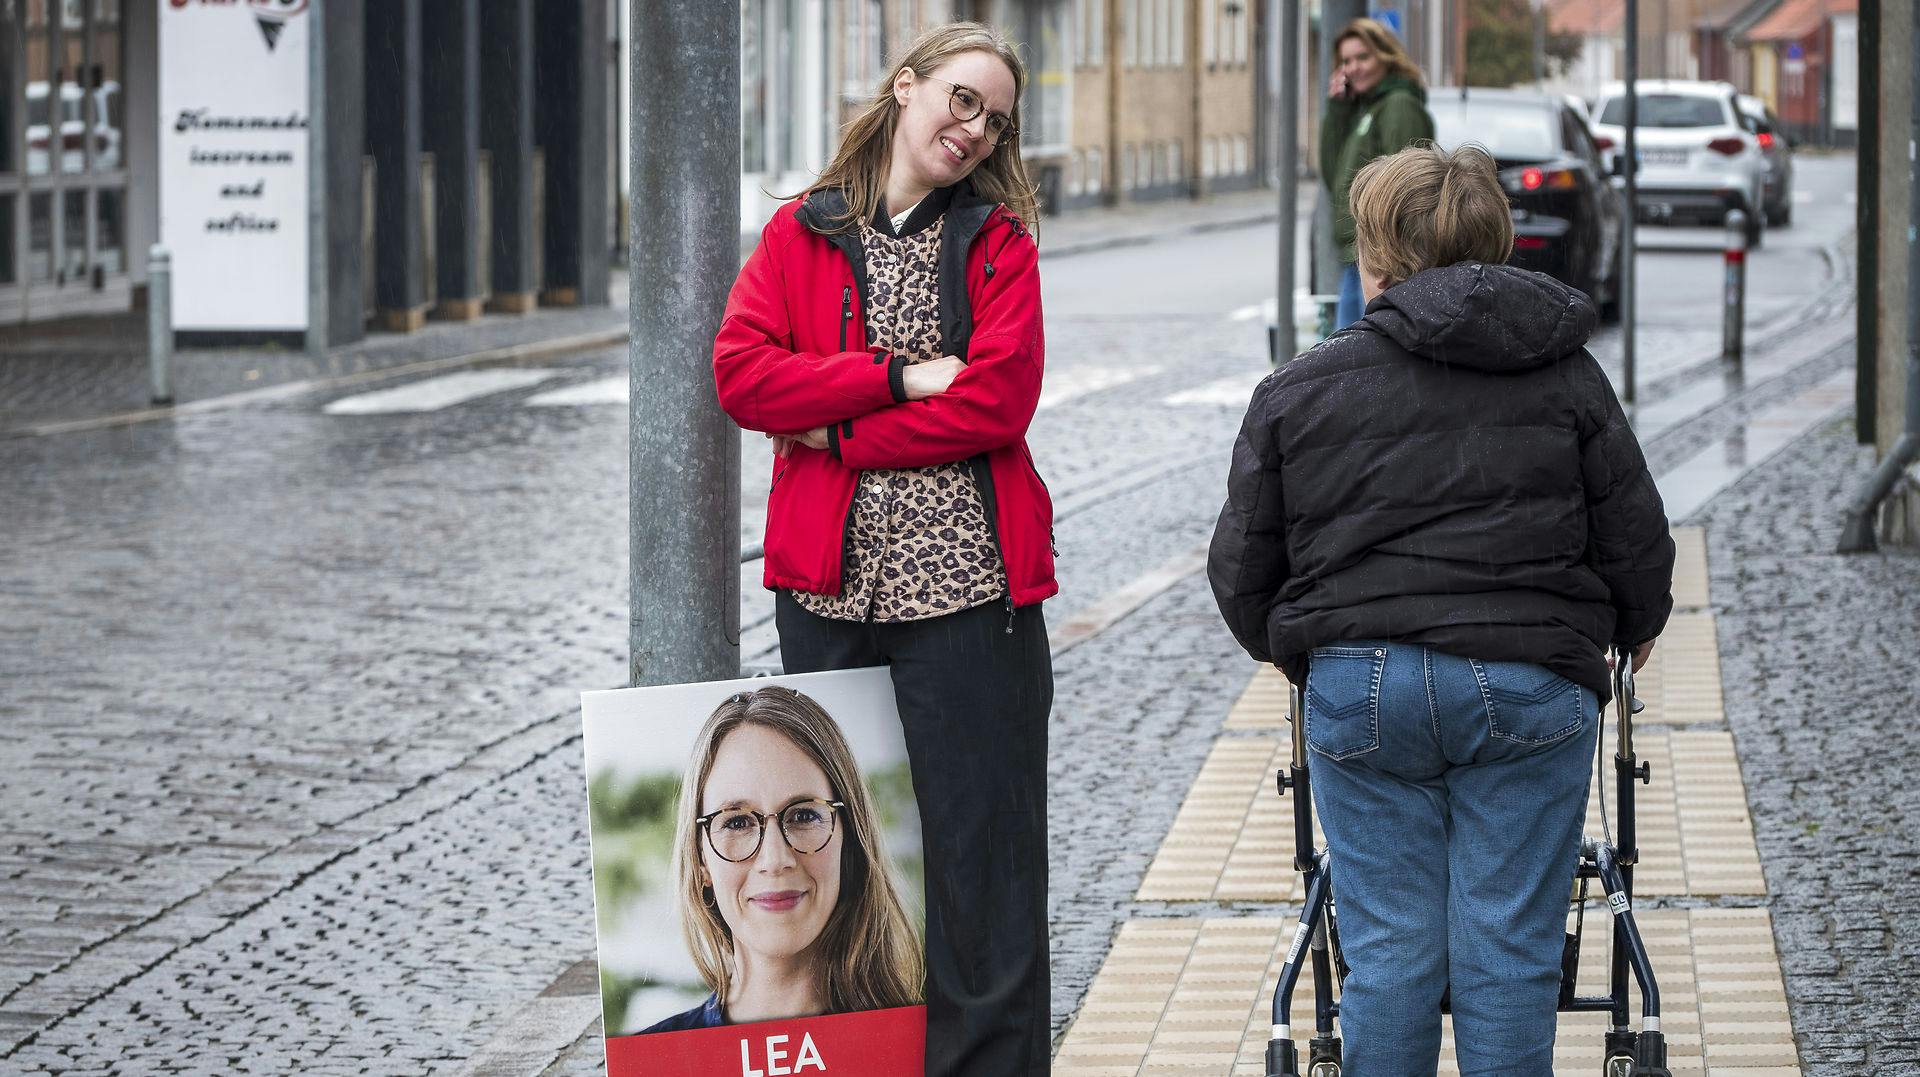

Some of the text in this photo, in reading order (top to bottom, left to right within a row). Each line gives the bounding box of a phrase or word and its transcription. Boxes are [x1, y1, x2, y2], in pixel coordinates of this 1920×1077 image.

[174, 106, 309, 132] Homemade
[190, 148, 293, 165] icecream
[220, 180, 265, 198] and
[205, 212, 279, 232] softice
[740, 1031, 827, 1077] LEA
